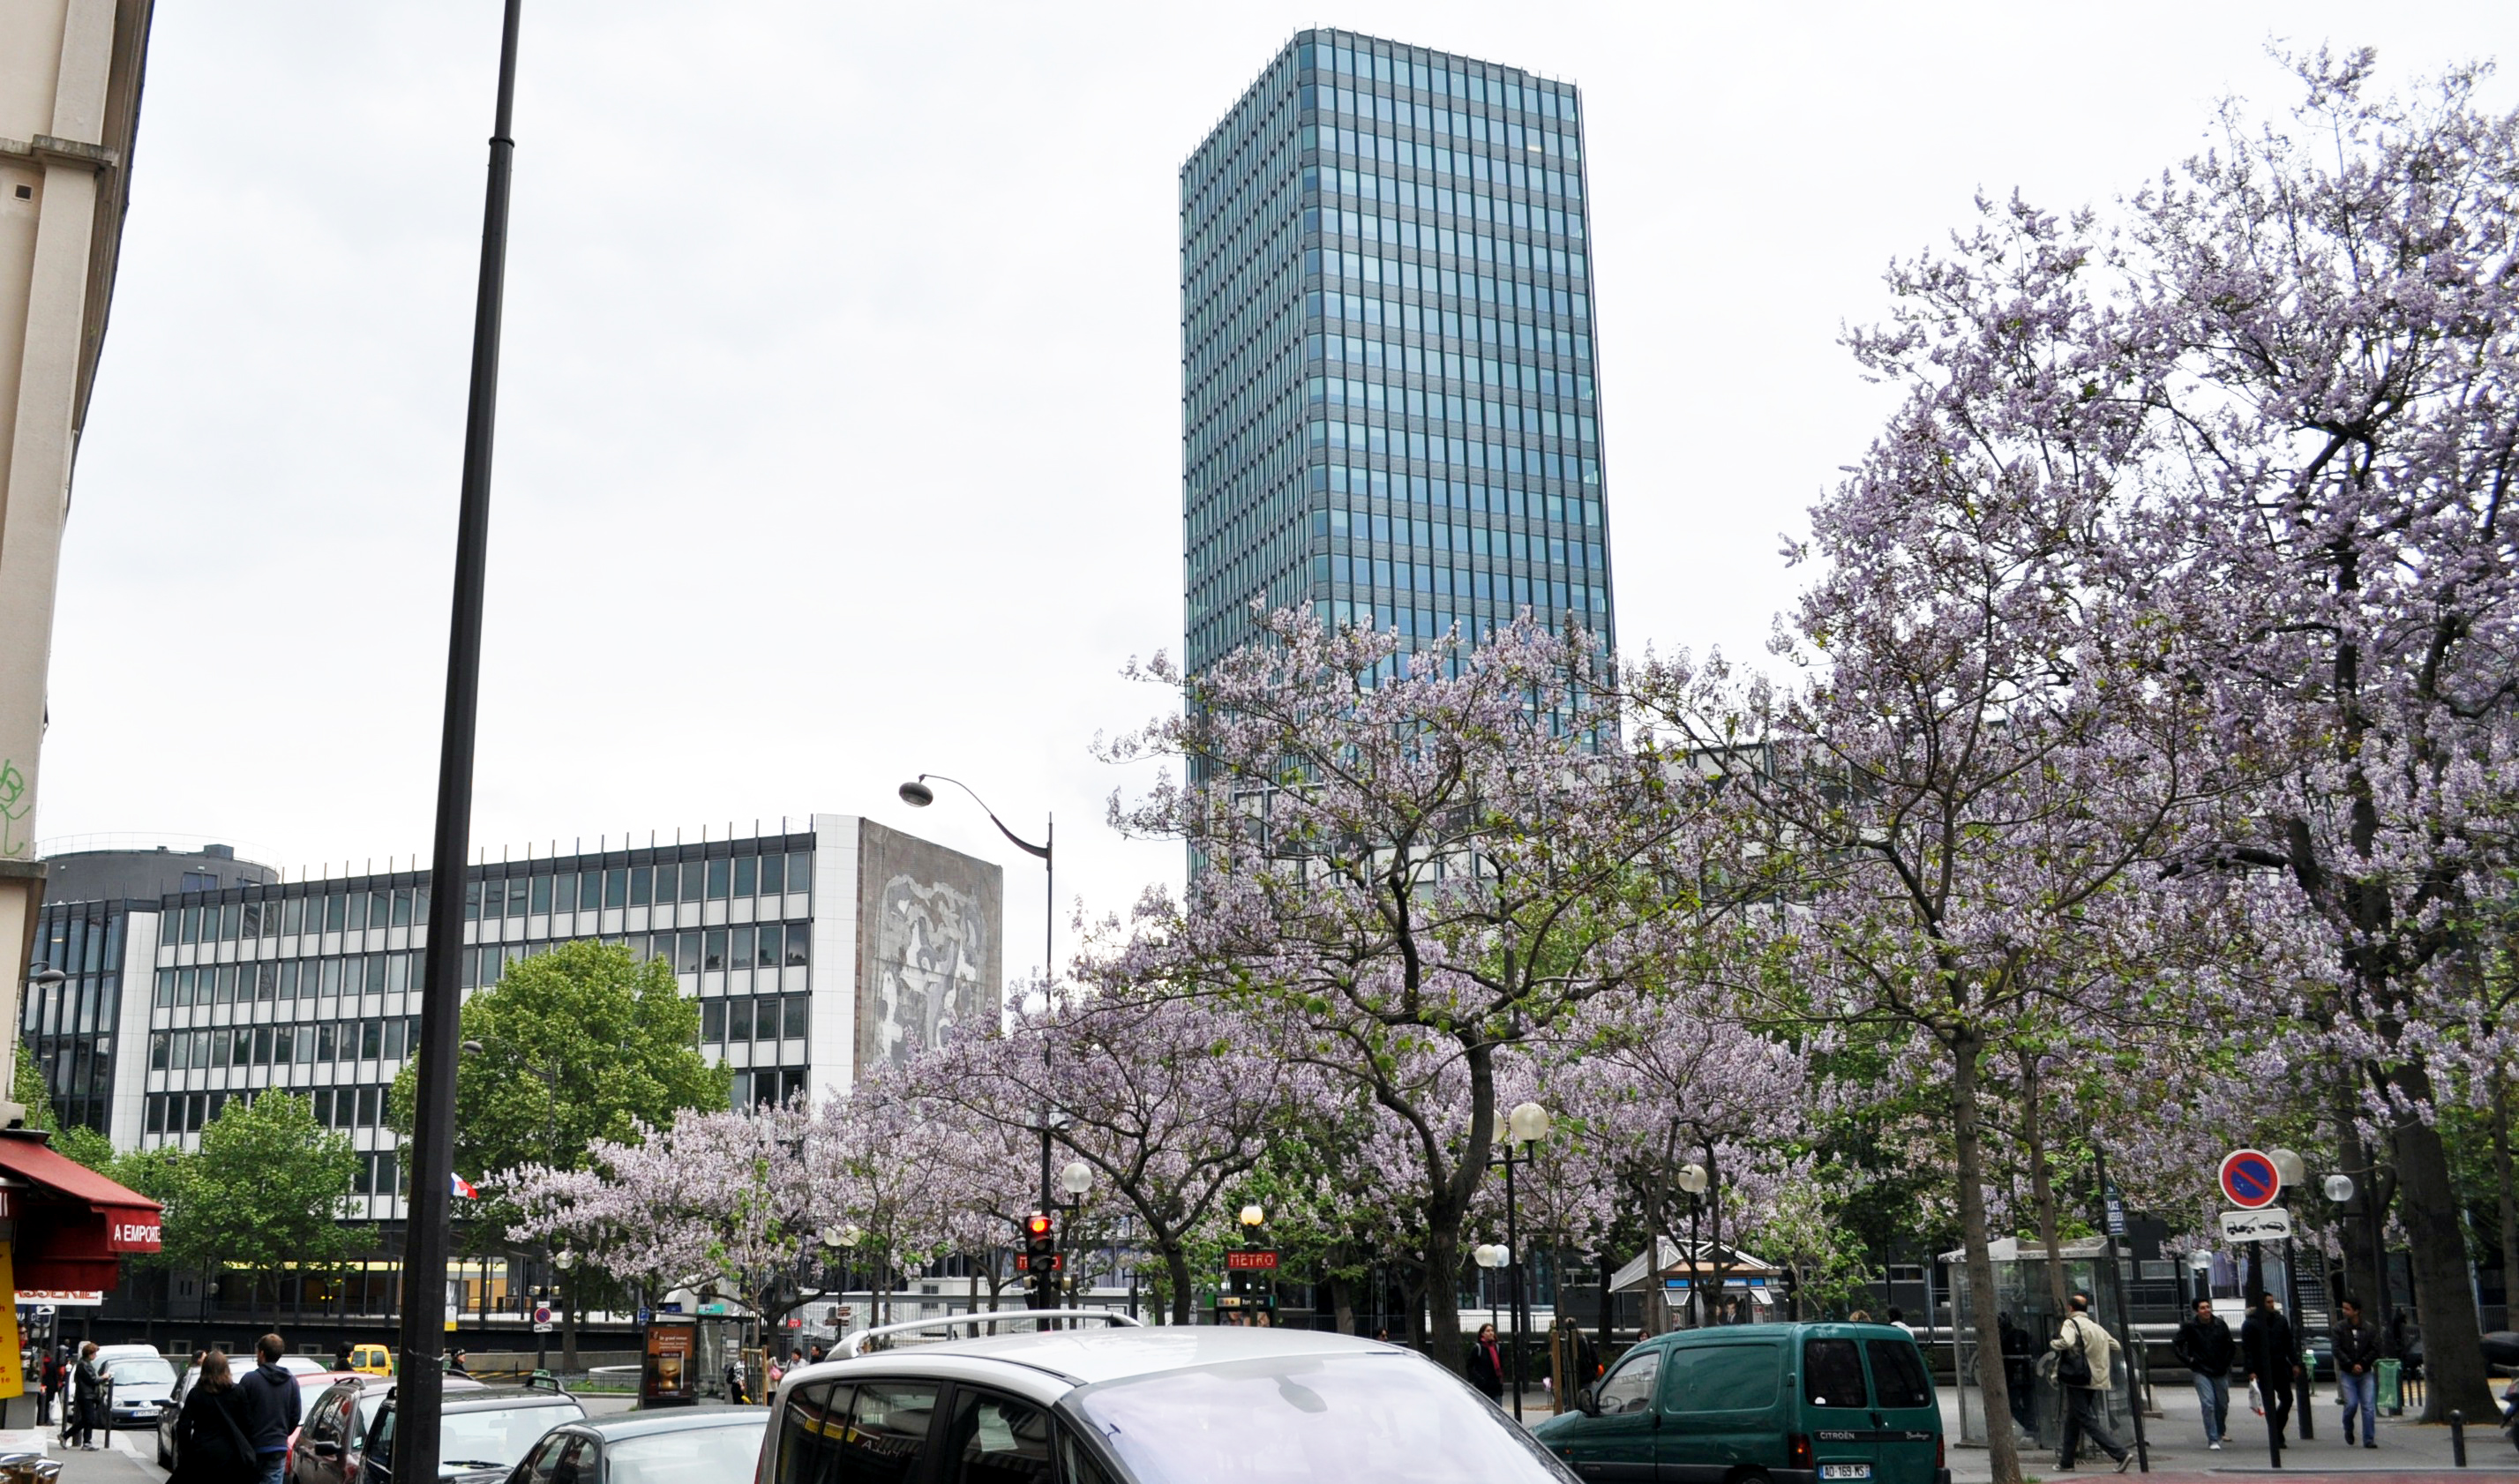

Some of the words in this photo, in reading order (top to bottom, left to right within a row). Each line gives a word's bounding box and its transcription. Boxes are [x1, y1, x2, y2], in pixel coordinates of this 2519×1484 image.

[114, 1224, 122, 1241] A
[1230, 1254, 1273, 1266] METRO
[1820, 1431, 1856, 1440] CITROËN
